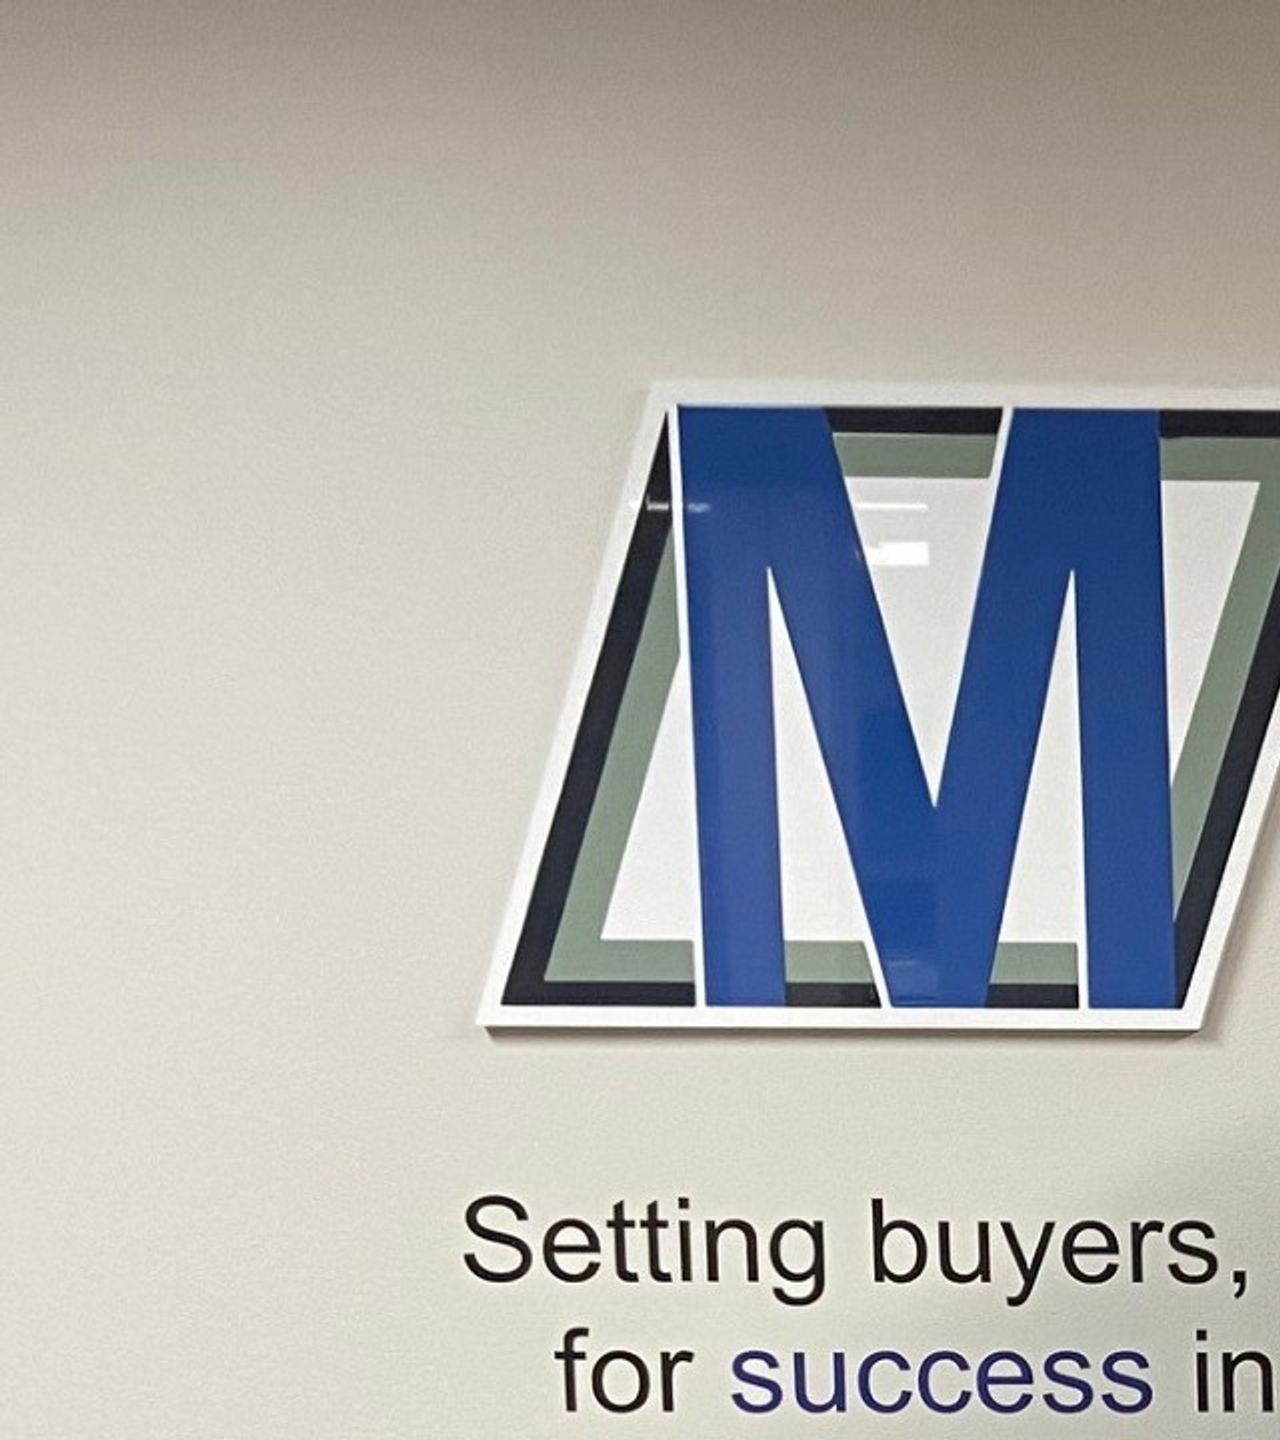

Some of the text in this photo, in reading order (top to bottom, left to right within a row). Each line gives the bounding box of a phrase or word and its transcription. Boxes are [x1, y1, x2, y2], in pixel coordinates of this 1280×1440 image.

[465, 1196, 825, 1306] Setting
[871, 1198, 1247, 1307] buyers,
[555, 1327, 695, 1413] for
[731, 1350, 1153, 1413] success
[1196, 1329, 1274, 1413] in
